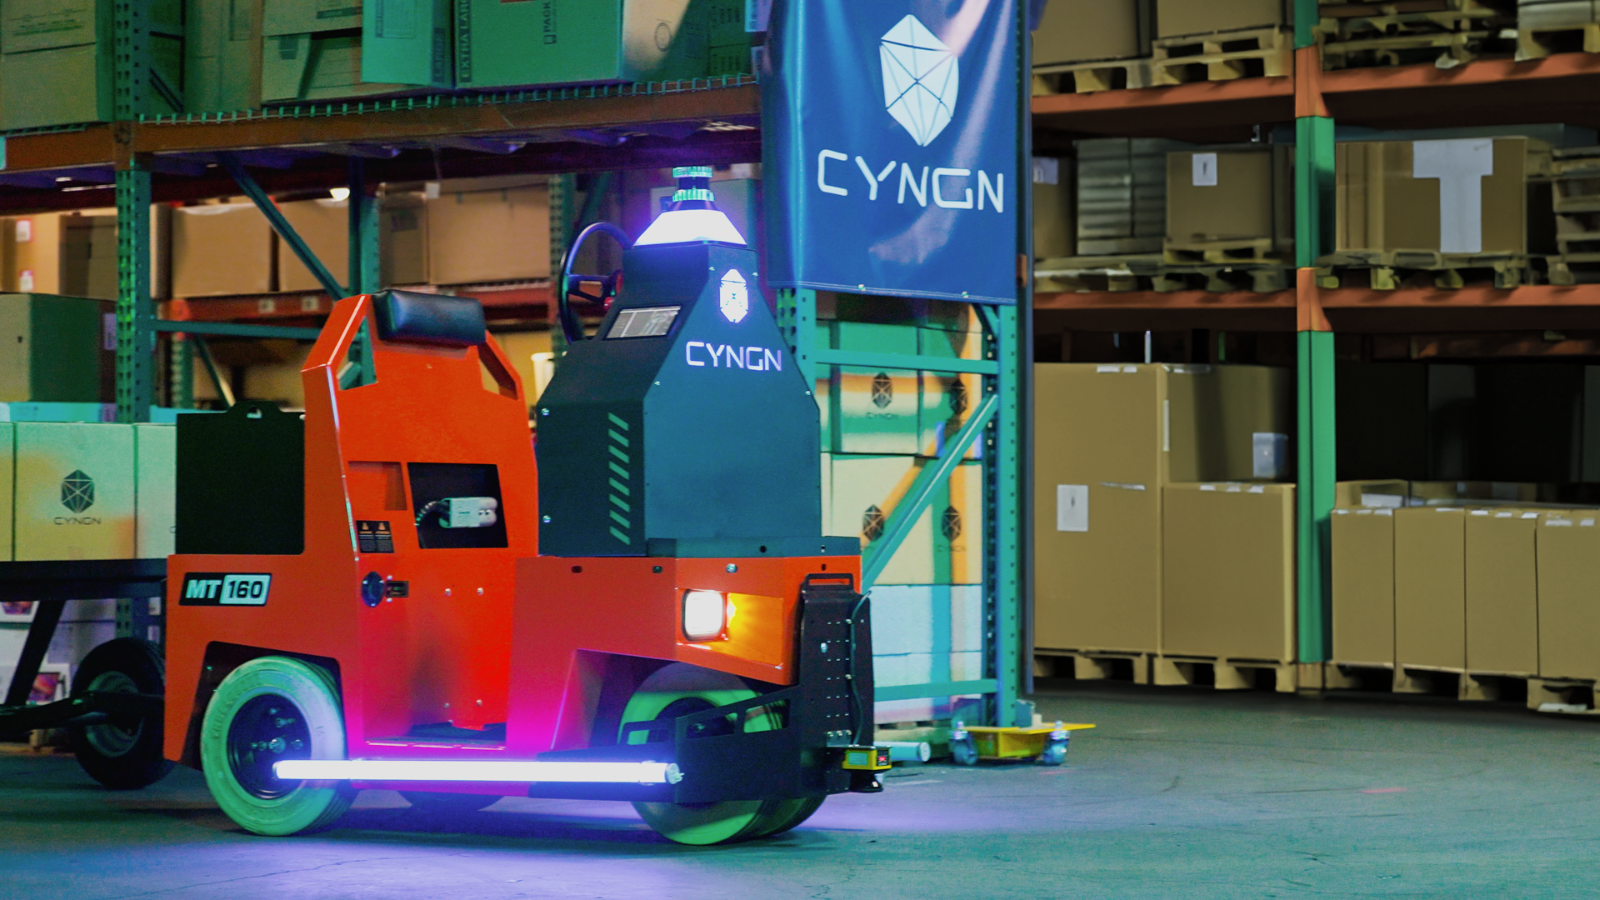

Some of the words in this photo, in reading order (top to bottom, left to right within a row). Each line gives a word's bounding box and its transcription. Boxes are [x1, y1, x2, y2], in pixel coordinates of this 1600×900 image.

[460, 33, 470, 78] EXTRA
[817, 149, 1004, 214] CYNGN
[686, 341, 782, 371] CYNGN
[185, 579, 222, 599] MT
[227, 580, 263, 599] 160
